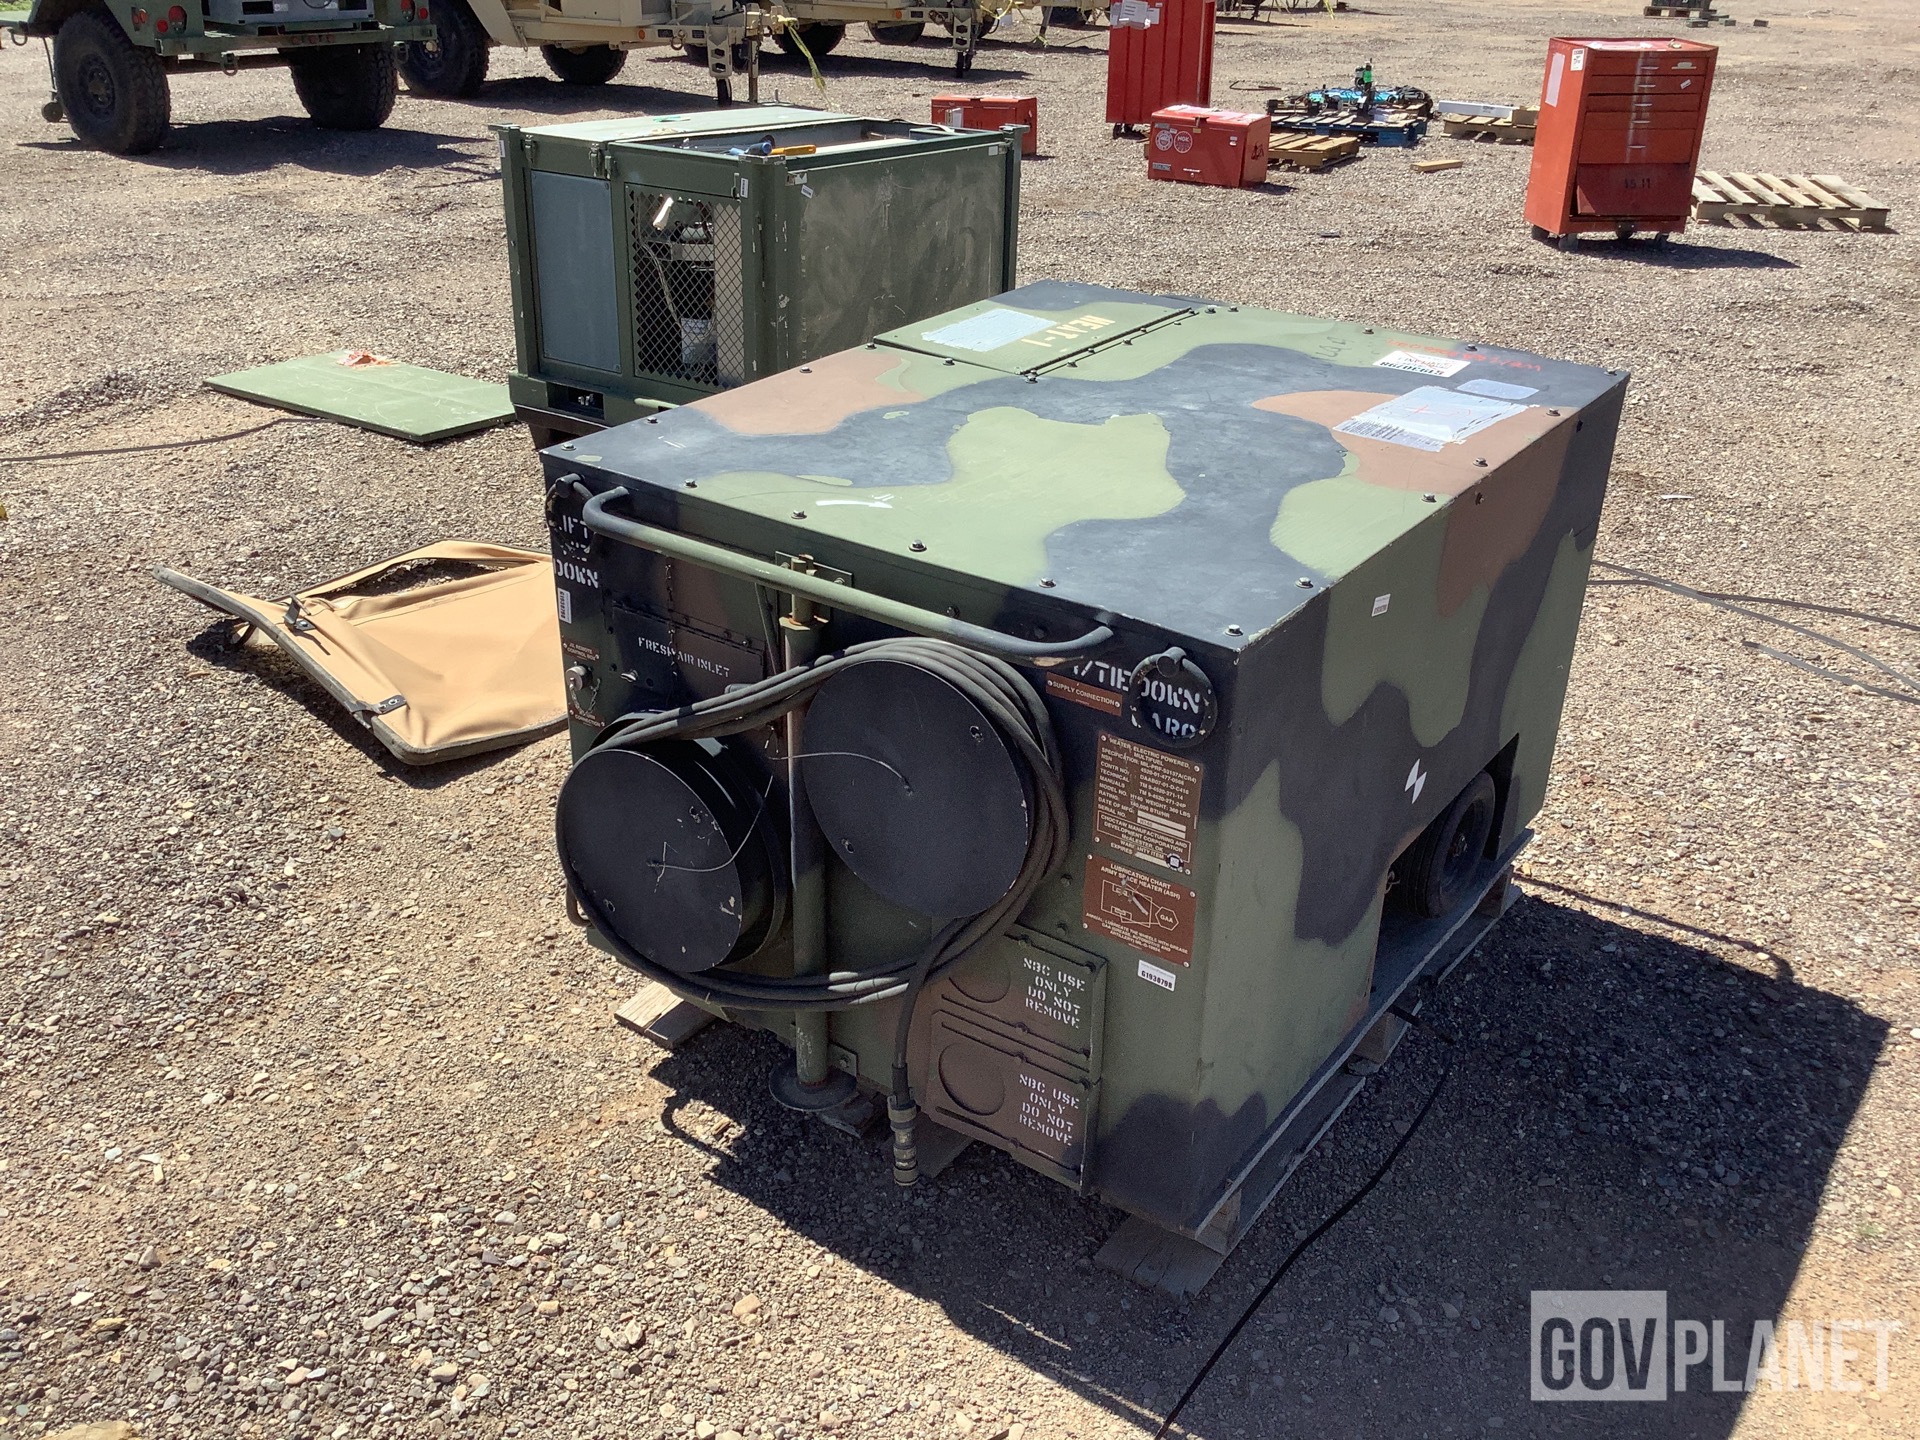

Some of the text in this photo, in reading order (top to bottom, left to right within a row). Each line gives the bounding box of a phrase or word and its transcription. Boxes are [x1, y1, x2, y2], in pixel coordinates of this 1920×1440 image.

[558, 515, 588, 539] IFT
[677, 651, 694, 665] AIR
[697, 658, 730, 678] INLET
[1052, 681, 1075, 693] SUPPLY
[1075, 688, 1115, 705] CONNECTION
[1133, 747, 1161, 759] ELECTRIC
[1100, 762, 1119, 771] CONTR
[1100, 769, 1130, 782] TECHNICAL
[1099, 776, 1126, 788] MANUALS
[1099, 784, 1118, 793] MODEL
[1098, 798, 1113, 806] DATE
[1098, 804, 1117, 814] SERIAL
[1101, 815, 1128, 827] CHOCTAW
[1128, 824, 1174, 844] MANUFACTURING
[1104, 822, 1183, 853] DEVELOPMENT CORPORATION
[1110, 843, 1133, 854] EXPIRES
[1151, 851, 1164, 859] ITEM
[1100, 867, 1118, 876] ARMY
[1139, 881, 1163, 893] HEATER
[1163, 890, 1181, 900] (ASH)
[1110, 864, 1171, 889] LUBRICATION CHART
[1160, 915, 1174, 923] GAA
[1024, 957, 1085, 991] NBC USE
[1141, 970, 1173, 989] G1930798
[1035, 976, 1071, 997] ONLY
[1028, 985, 1080, 1015] DO NOT
[1025, 997, 1080, 1029] REMOVE
[1019, 1073, 1080, 1109] NBC USE
[1030, 1092, 1066, 1114] ONLY
[1022, 1102, 1073, 1132] DO NOT
[1019, 1114, 1073, 1146] REMOVE
